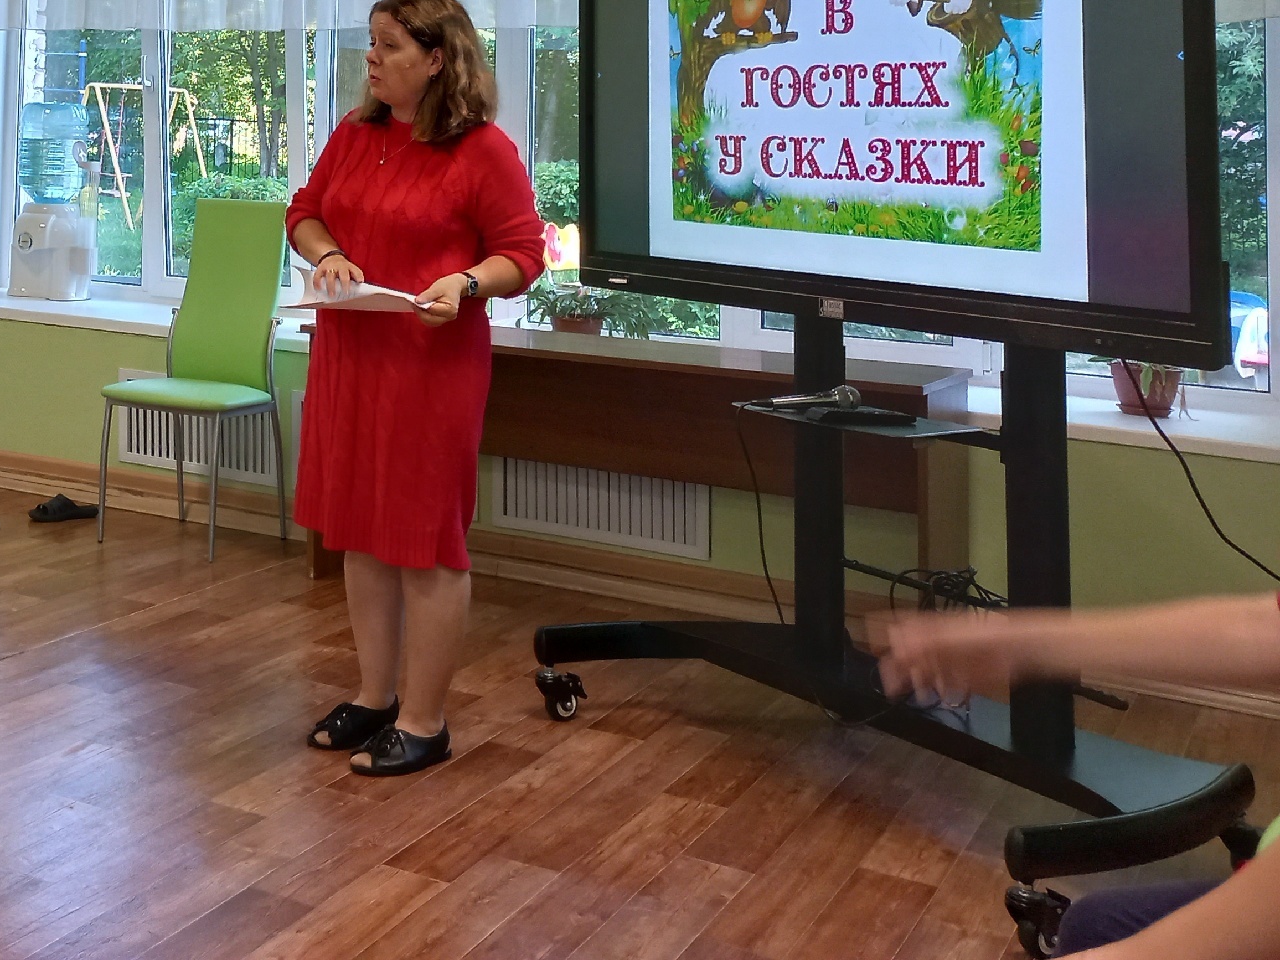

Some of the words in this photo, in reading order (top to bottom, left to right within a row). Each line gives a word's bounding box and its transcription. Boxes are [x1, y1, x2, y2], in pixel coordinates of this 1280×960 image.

[740, 62, 950, 109] ГОСТЯХ
[715, 135, 747, 175] У
[760, 135, 985, 187] СКАЗКИ
